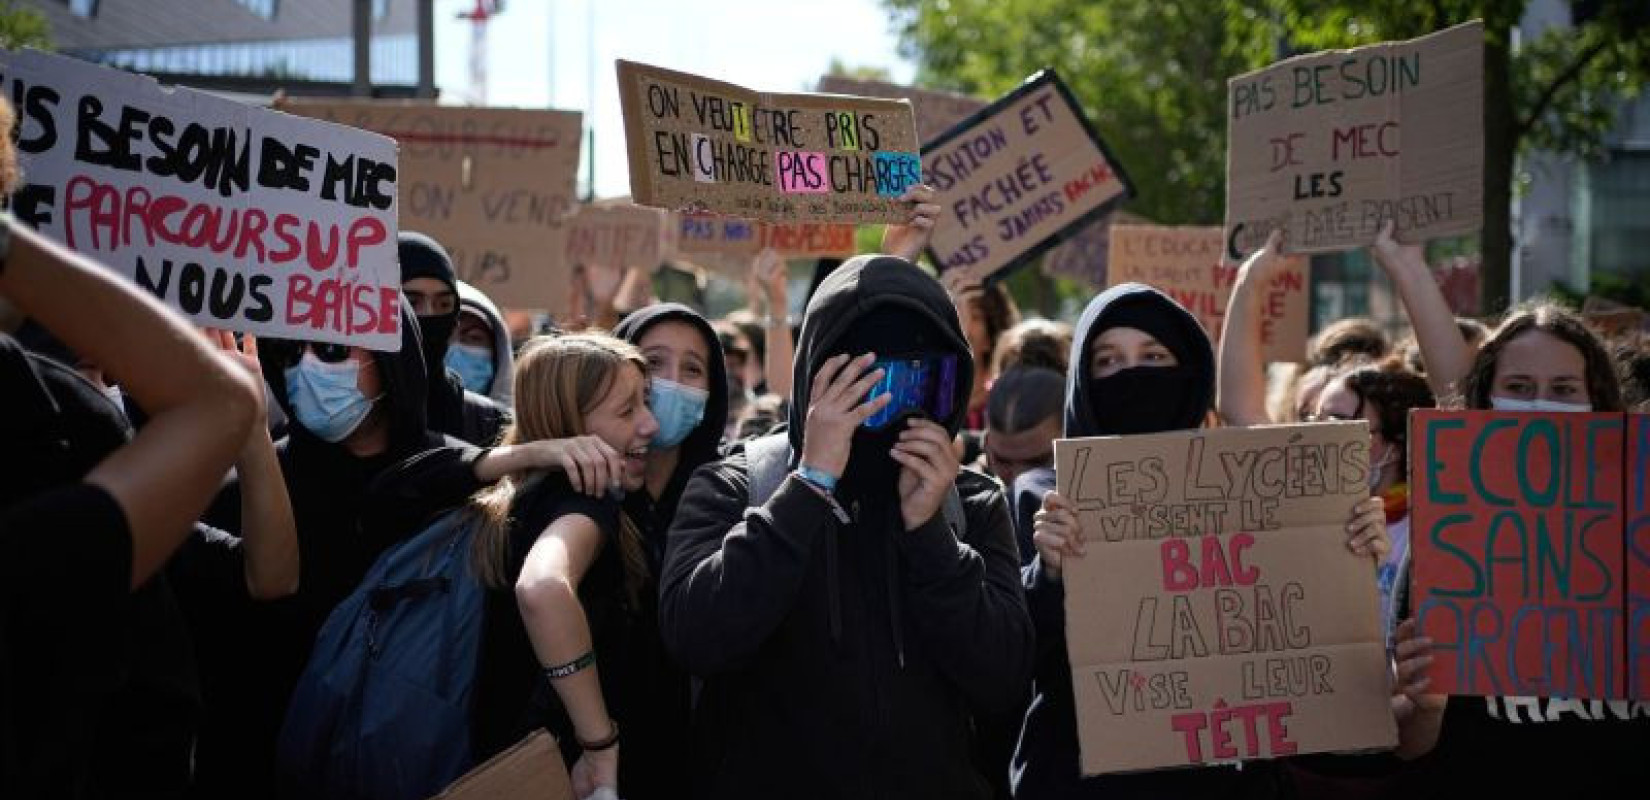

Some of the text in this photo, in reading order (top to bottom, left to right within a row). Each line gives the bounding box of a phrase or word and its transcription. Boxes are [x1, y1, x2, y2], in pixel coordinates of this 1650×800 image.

[647, 83, 680, 119] ON
[690, 91, 746, 136] VEUT
[824, 110, 881, 151] PRIS
[1019, 94, 1055, 137] ET
[1233, 52, 1420, 119] PAS BESOIN
[74, 95, 252, 197] BESOIN
[257, 136, 321, 192] DE
[319, 151, 397, 211] MEC
[654, 131, 692, 177] EN
[696, 136, 773, 187] CHARGE
[1269, 120, 1401, 173] DE MEC
[1293, 170, 1344, 201] LES
[63, 174, 387, 272] PARCOURSUP
[134, 256, 397, 336] NOUS BAISE
[1068, 432, 1369, 511] LES LYCÉENS
[1426, 418, 1622, 508] ECOLE
[1240, 499, 1282, 532] LE
[1160, 532, 1260, 592] BAC
[1429, 510, 1614, 601] SANS
[1130, 582, 1312, 662] LA BAC
[1418, 598, 1623, 698] ARGENT
[1240, 654, 1336, 700] LEUR
[1170, 697, 1299, 763] TÊTE
